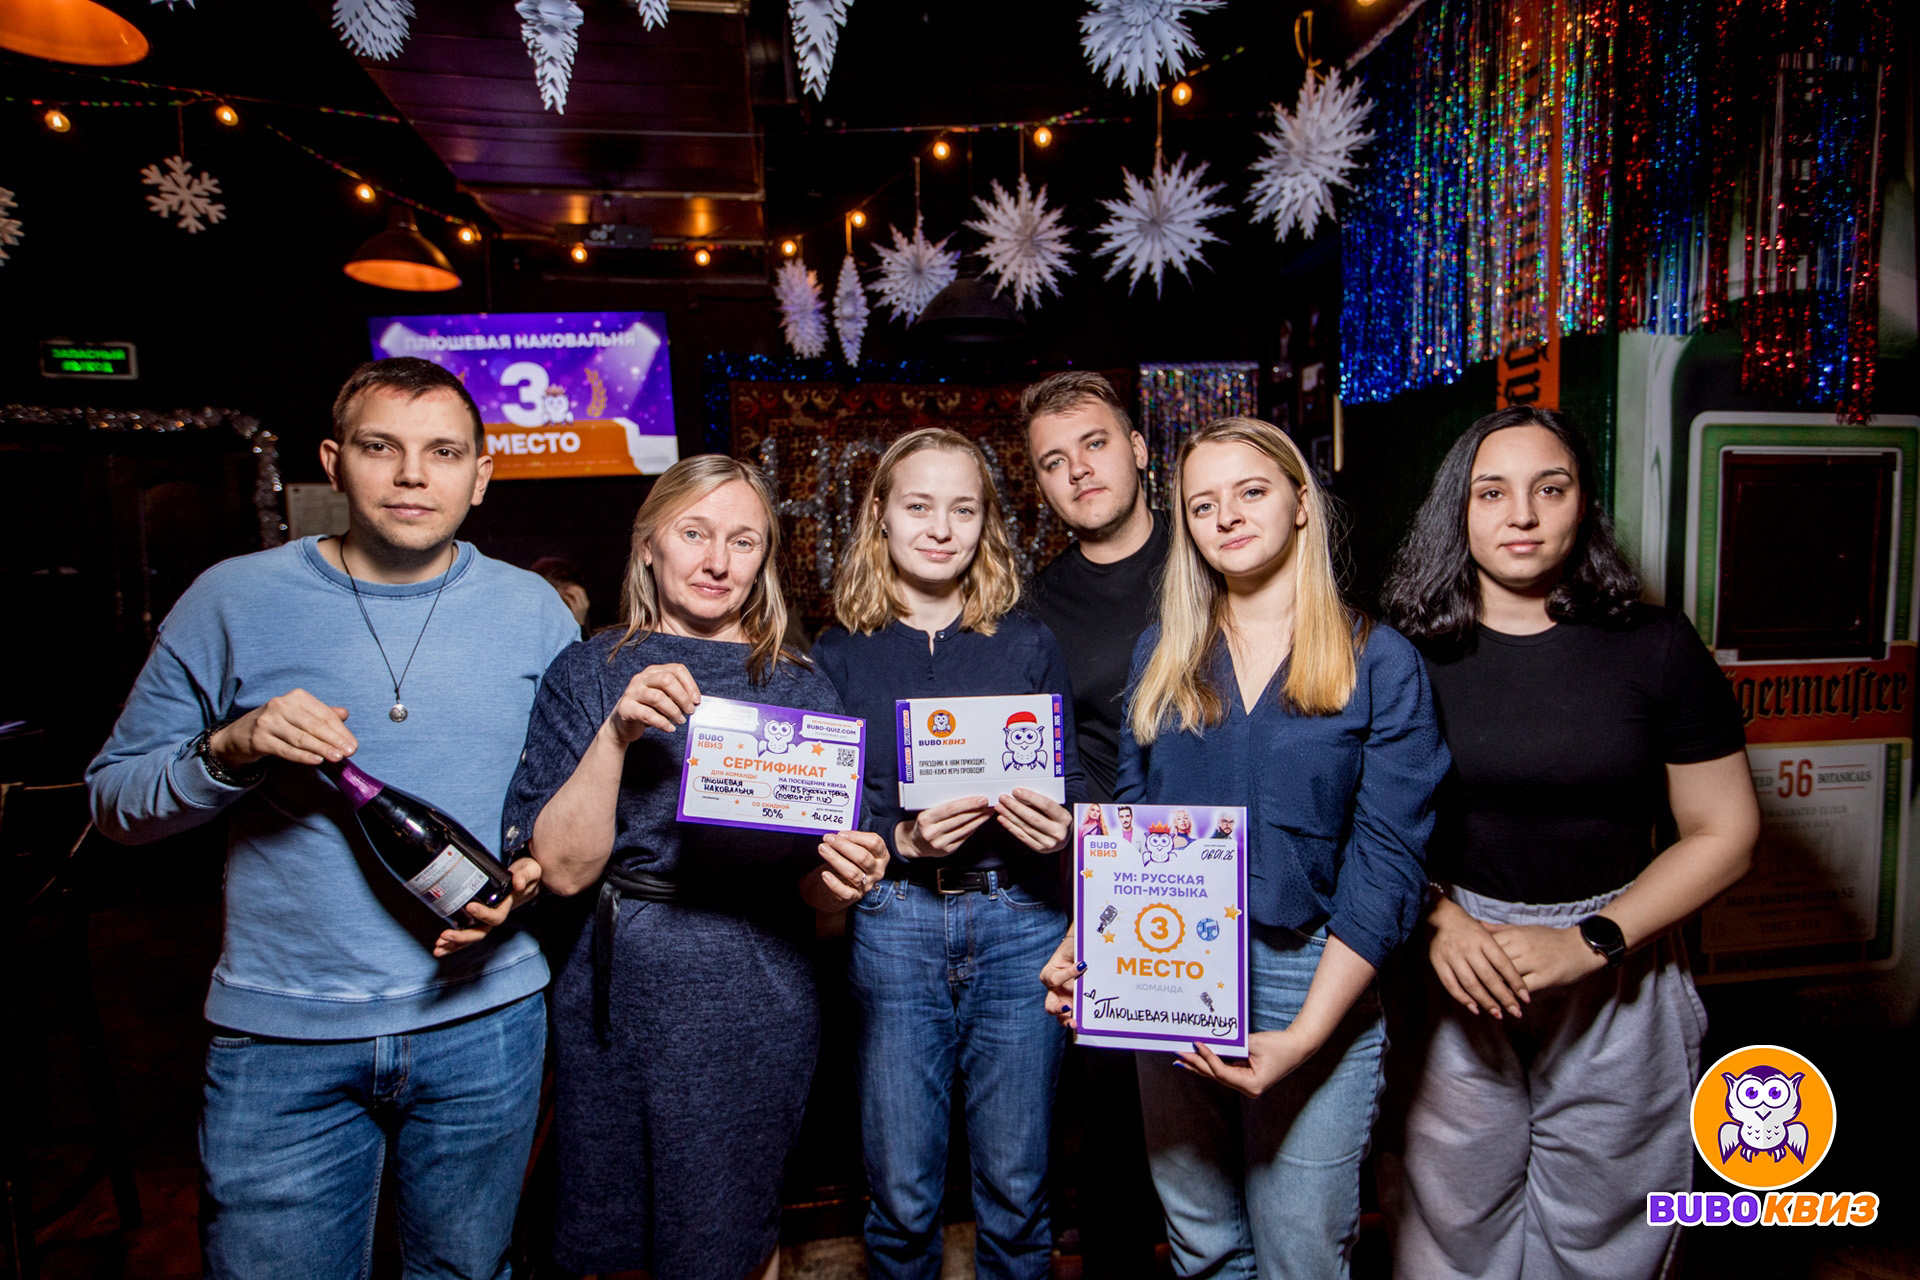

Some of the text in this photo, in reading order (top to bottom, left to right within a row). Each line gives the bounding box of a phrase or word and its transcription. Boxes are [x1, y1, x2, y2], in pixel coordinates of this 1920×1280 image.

[404, 331, 637, 351] ПЛЮШЕВАЯ НАКОВАЛЬНЯ
[500, 361, 550, 428] 3
[486, 431, 581, 456] МЕСТО
[806, 724, 856, 735] BUBO-QUIZ.COM
[698, 733, 724, 742] BUBO
[942, 738, 967, 746] КВИЗ
[697, 740, 723, 750] КВИЗ
[723, 756, 827, 778] СЕРТИФИКАТ
[960, 766, 985, 774] ПРОВОДИТ
[725, 771, 758, 779] КОМАНДЫ
[1777, 758, 1813, 798] 56
[1817, 771, 1872, 784] BOTANICALS
[788, 778, 826, 788] ПОСЕЩЕНИЕ
[703, 784, 754, 796] НАКОВАЛЬНЯ
[762, 802, 790, 810] СКИДКОЙ
[762, 808, 783, 819] 50%
[1090, 841, 1117, 849] BUBO
[1090, 850, 1117, 858] КВИЗ
[1113, 872, 1205, 885] УМ: РУССКАЯ
[1113, 885, 1208, 898] ПОП-МУЗЫКА
[1150, 916, 1169, 940] 3
[1116, 956, 1205, 980] МЕСТО
[1136, 983, 1184, 994] КОМАНДА
